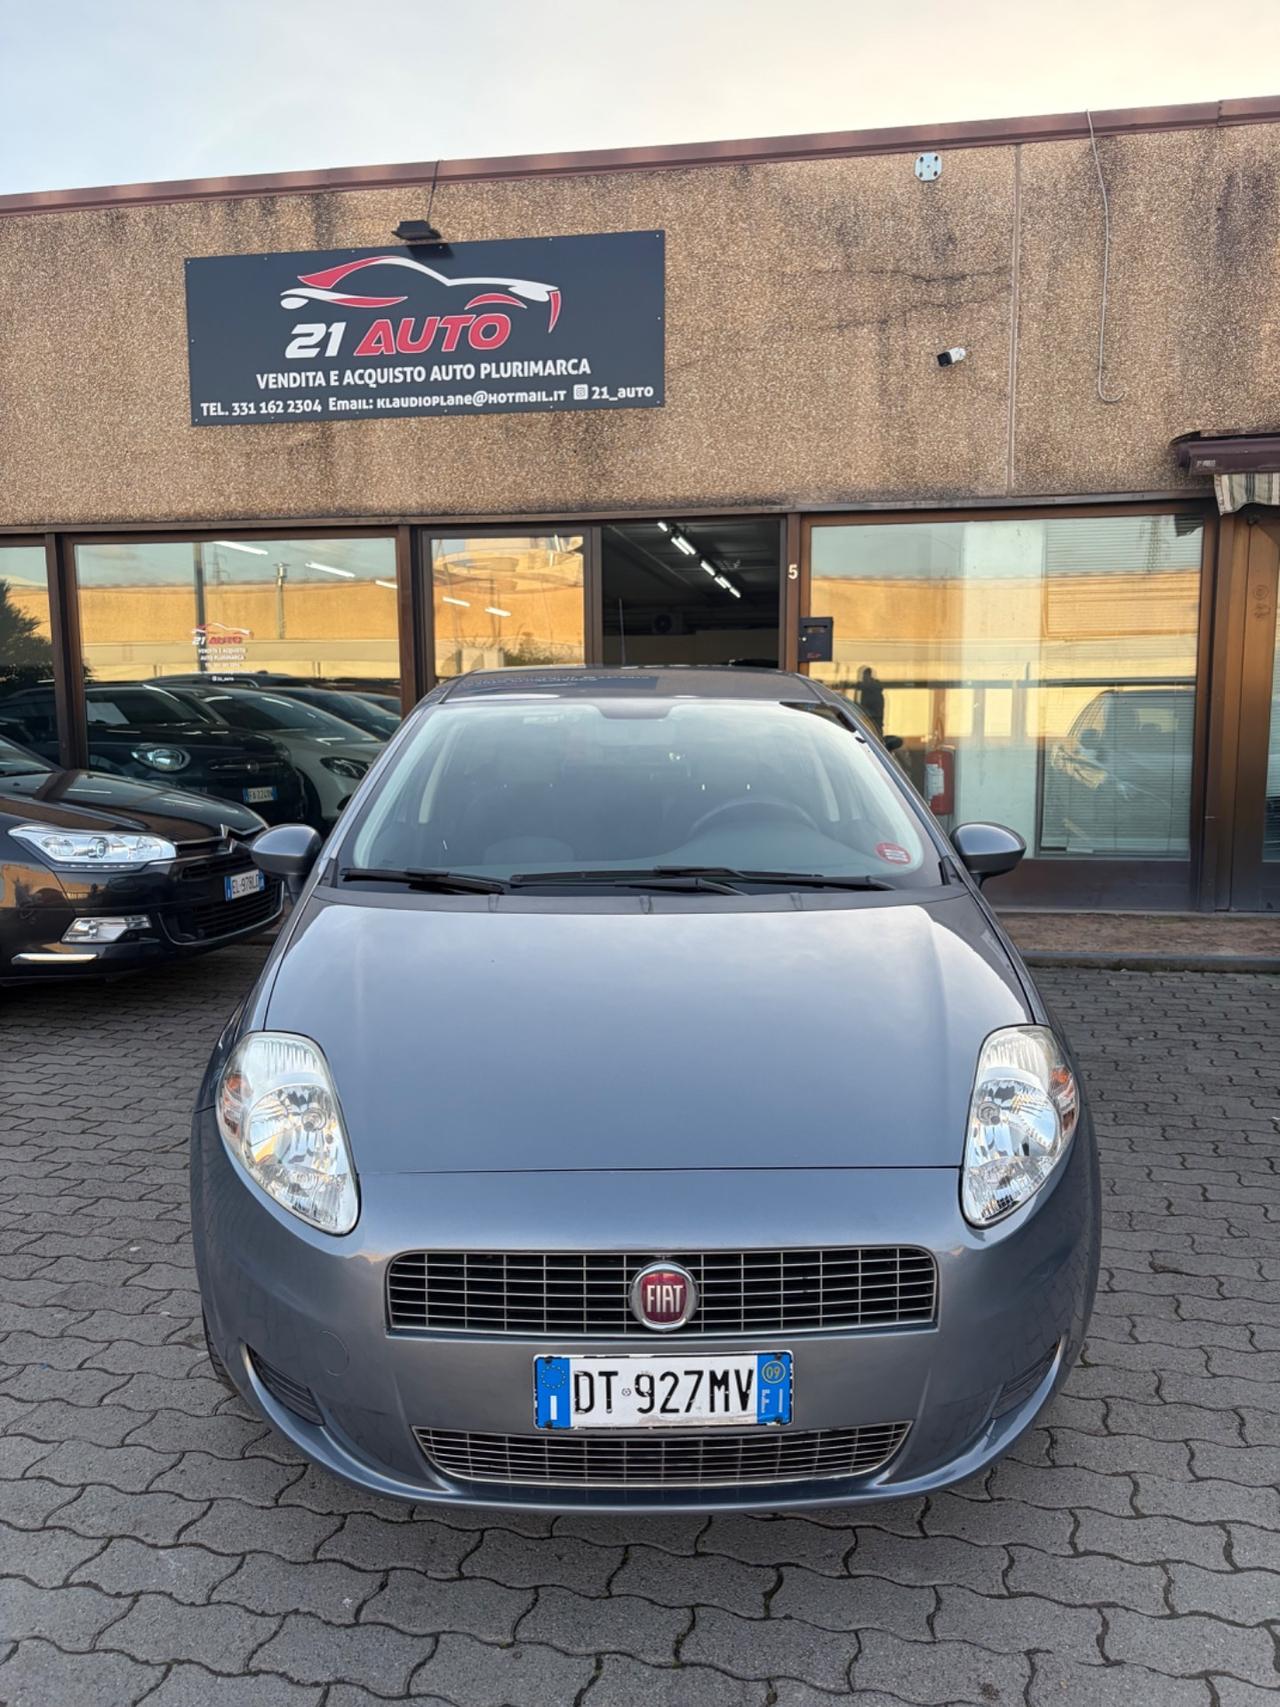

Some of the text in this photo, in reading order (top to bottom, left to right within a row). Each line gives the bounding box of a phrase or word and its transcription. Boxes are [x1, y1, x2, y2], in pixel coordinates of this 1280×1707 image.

[285, 313, 511, 358] 21 AUTO
[256, 358, 591, 390] VENDITA E ACQUISTO AUTO PLURIMARCA
[200, 402, 229, 416] TEL.
[232, 401, 256, 416] 331
[260, 400, 284, 414] 162
[287, 399, 322, 413] 2304
[788, 564, 798, 579] 5
[647, 1284, 684, 1313] FIAT
[573, 1369, 619, 1414] DT
[634, 1368, 754, 1414] 927MV
